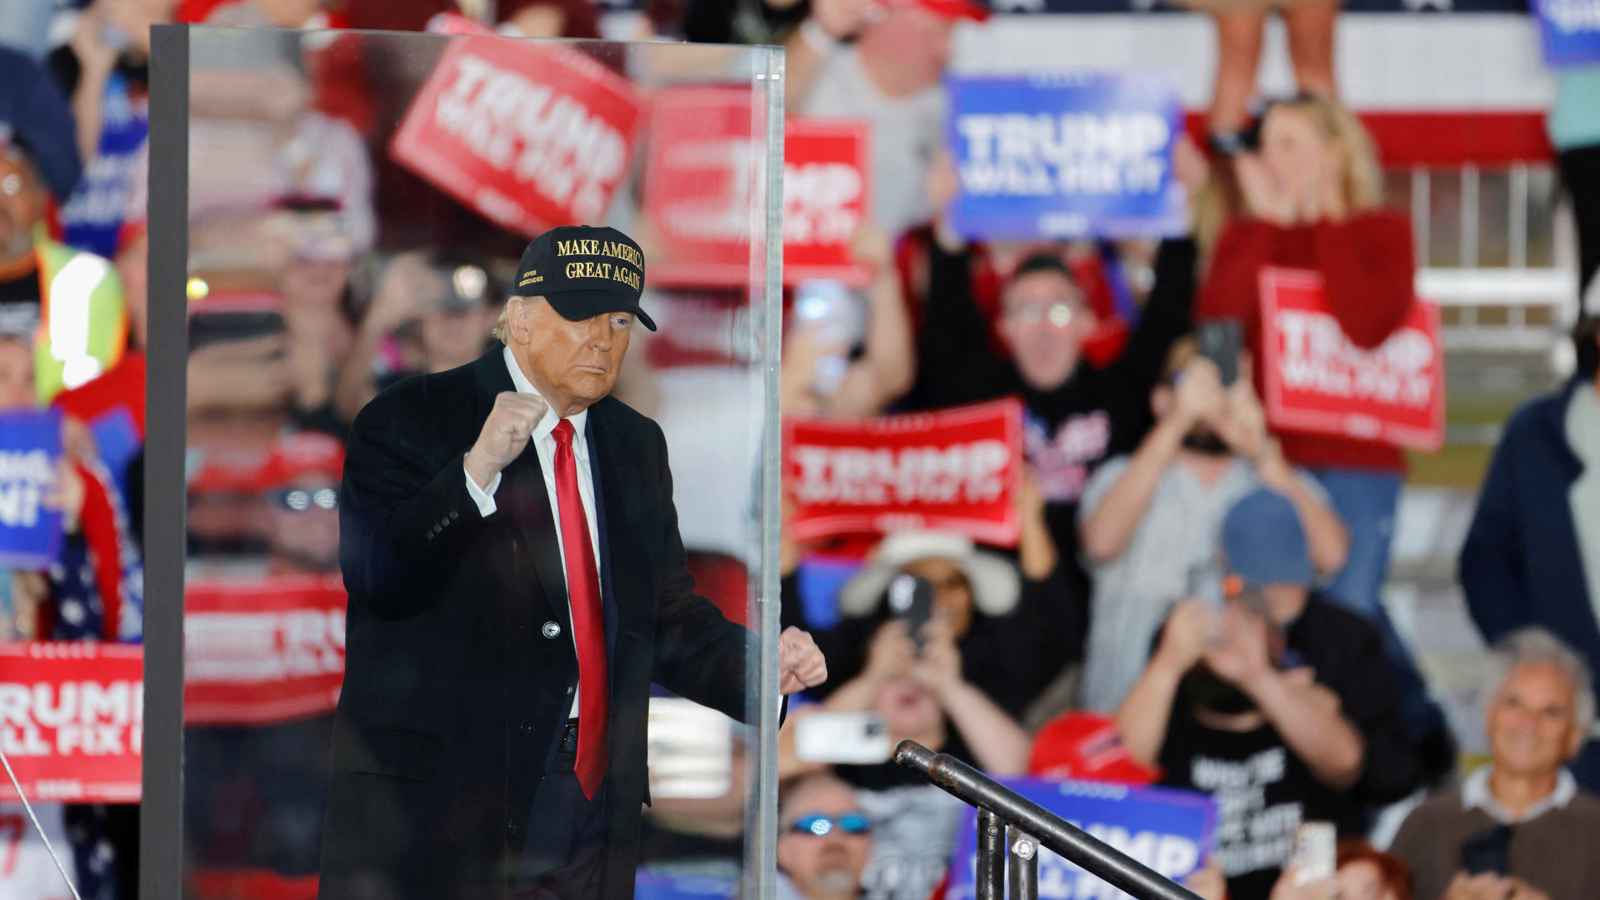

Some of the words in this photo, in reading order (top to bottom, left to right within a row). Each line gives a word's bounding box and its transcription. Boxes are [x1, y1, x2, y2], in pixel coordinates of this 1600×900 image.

[449, 54, 625, 188] TRUMP
[957, 112, 1170, 160] TRUMP
[557, 239, 600, 257] MAKE
[566, 261, 611, 279] GREAT
[612, 265, 640, 289] AGAIN
[792, 438, 1010, 486] TRUMP
[0, 681, 143, 727] RUM
[0, 724, 50, 757] LL
[57, 723, 124, 757] FIX
[131, 722, 142, 756] I
